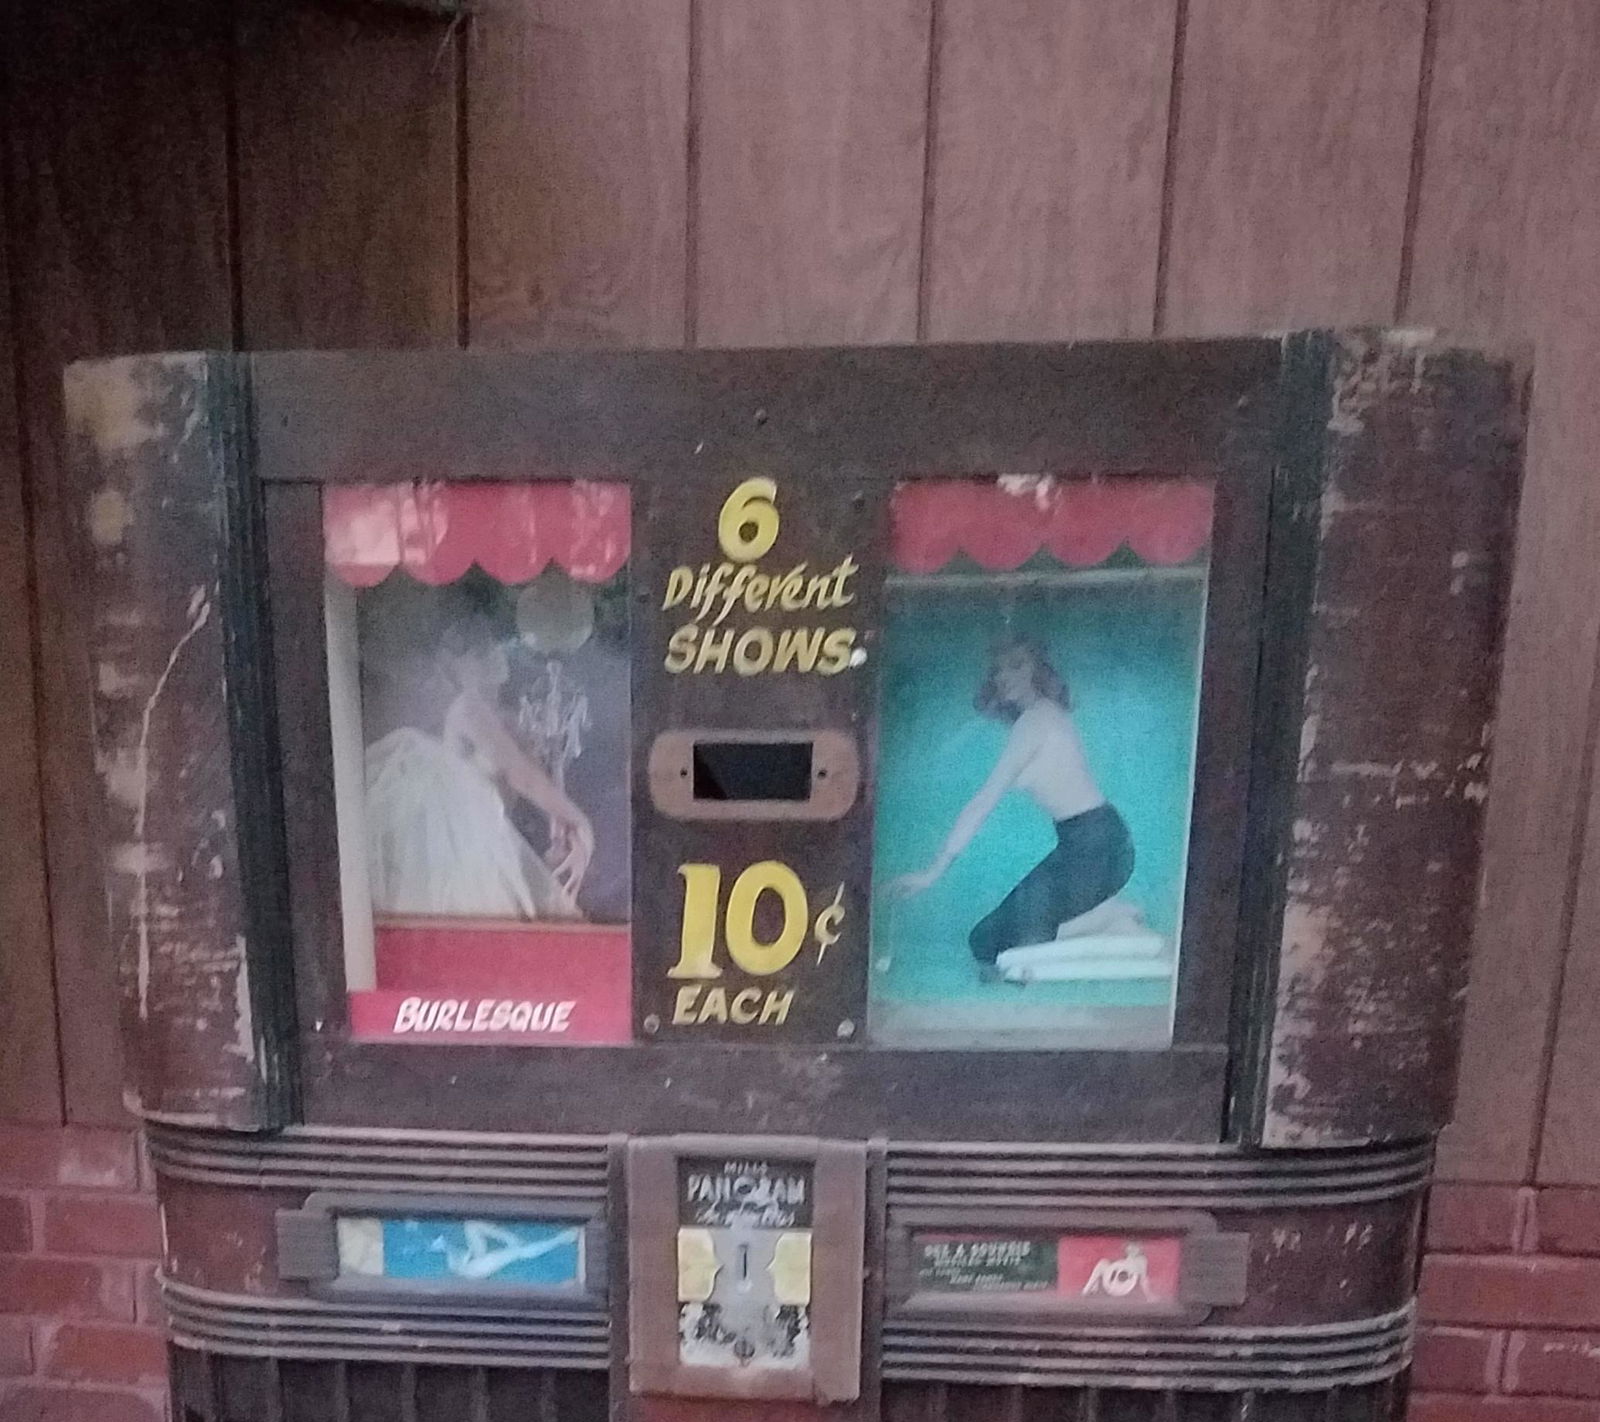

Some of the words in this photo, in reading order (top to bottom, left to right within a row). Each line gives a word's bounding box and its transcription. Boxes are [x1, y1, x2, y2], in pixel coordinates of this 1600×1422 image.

[718, 476, 780, 562] 6
[662, 553, 860, 627] Different
[664, 623, 857, 677] SHOWS
[393, 996, 576, 1033] BURLESQUE
[672, 984, 796, 1025] EACH
